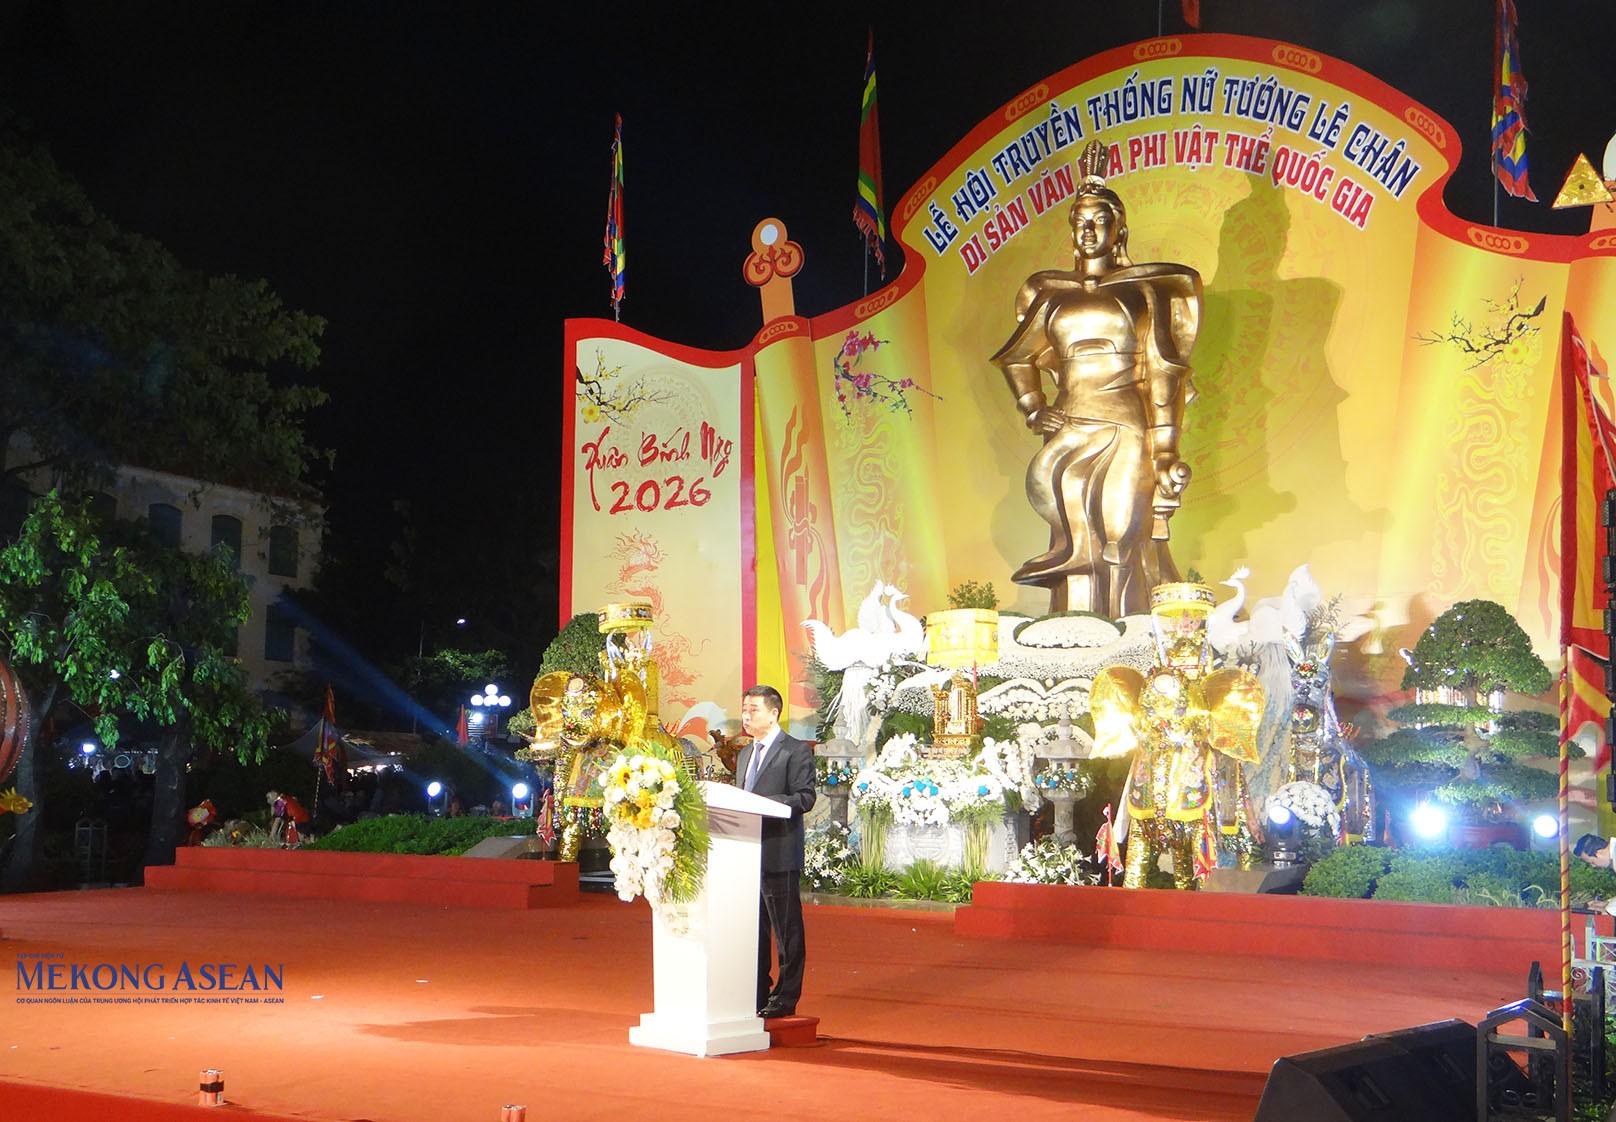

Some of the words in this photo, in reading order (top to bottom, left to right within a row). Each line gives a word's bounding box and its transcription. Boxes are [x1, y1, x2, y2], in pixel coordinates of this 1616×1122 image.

[923, 202, 959, 254] LỄ
[952, 168, 997, 223] HỘI
[991, 103, 1084, 184] TRUYỀN
[1087, 71, 1173, 131] THỐNG
[1181, 68, 1218, 113] NỮ
[1223, 75, 1310, 131] TƯỚNG
[1308, 103, 1349, 149] LÊ
[1343, 123, 1420, 198] CHÂN
[959, 234, 988, 273] DI
[983, 204, 1029, 251] SẢN
[1028, 165, 1075, 215] VĂN
[1128, 132, 1166, 170] PHI
[1174, 124, 1219, 169] VẬT
[1225, 127, 1273, 174] THỂ
[1271, 147, 1334, 201] QUỐC
[1331, 178, 1374, 229] GIA
[581, 426, 628, 512] Xuân
[638, 427, 690, 467] Bính
[609, 475, 711, 514] 2026
